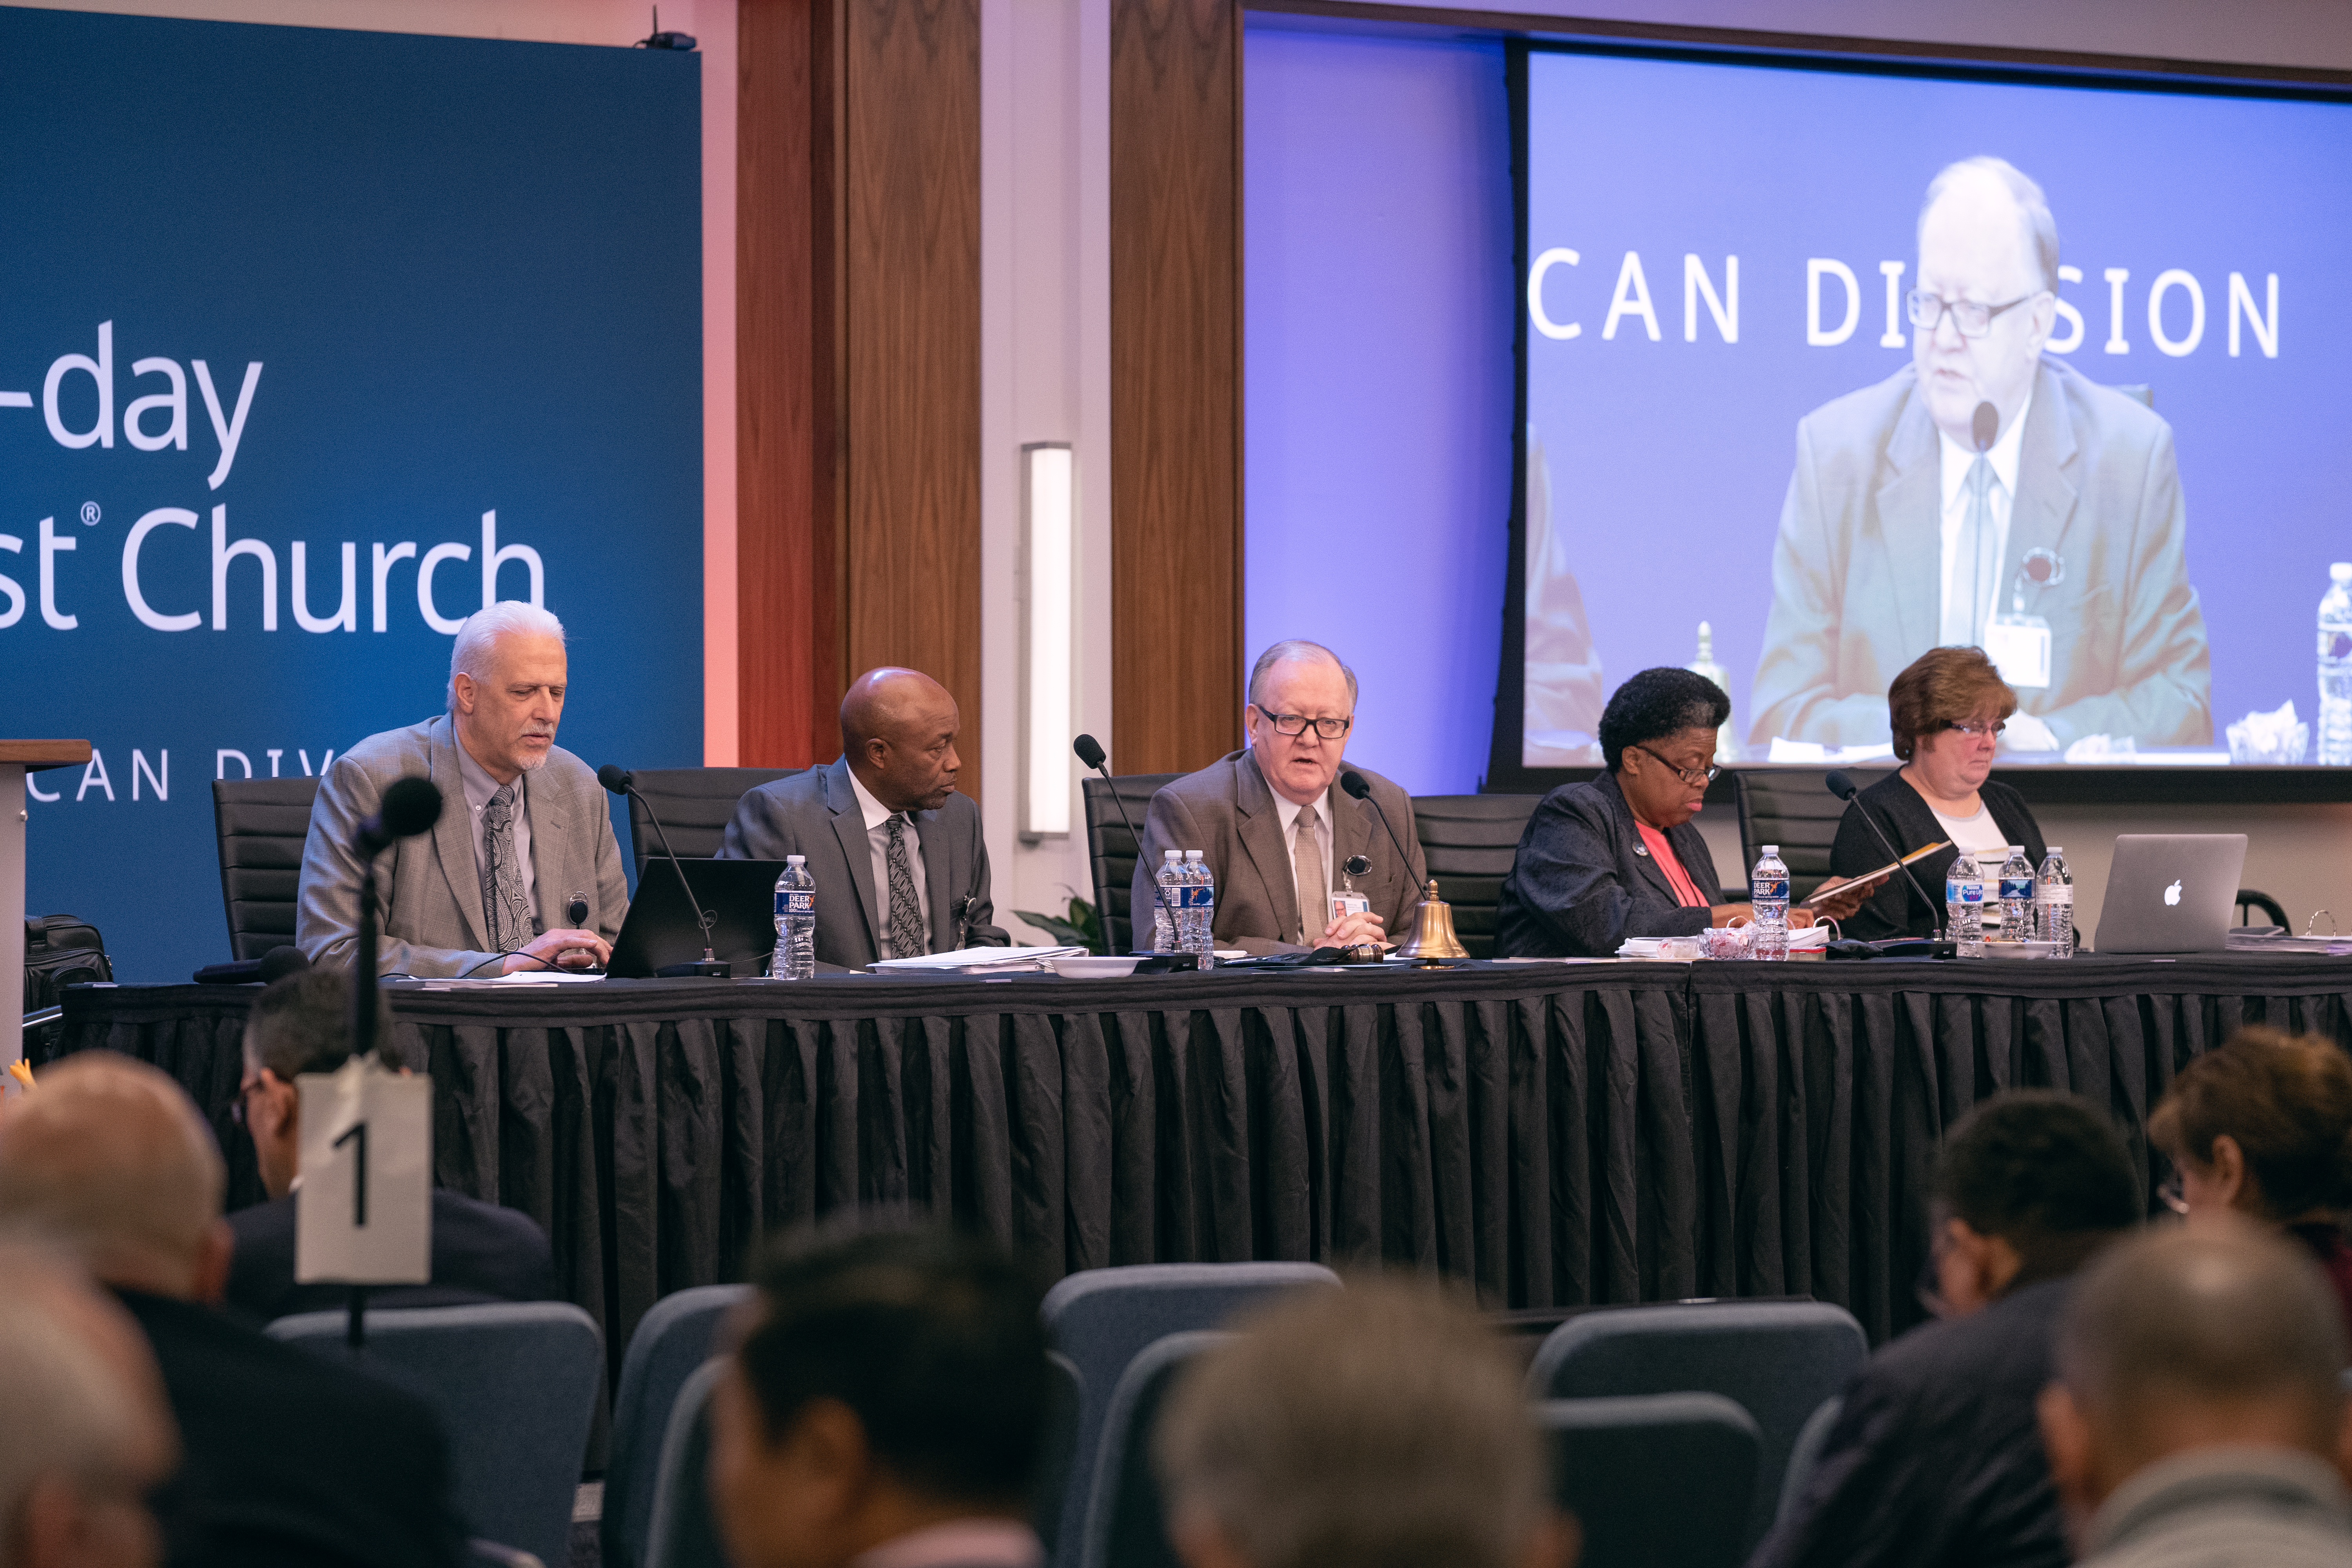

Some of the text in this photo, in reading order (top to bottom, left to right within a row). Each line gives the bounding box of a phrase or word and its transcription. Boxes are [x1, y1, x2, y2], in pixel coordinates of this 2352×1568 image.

[1527, 247, 2279, 358] CAN DISION
[122, 503, 545, 635] Church
[332, 1120, 366, 1226] 1
